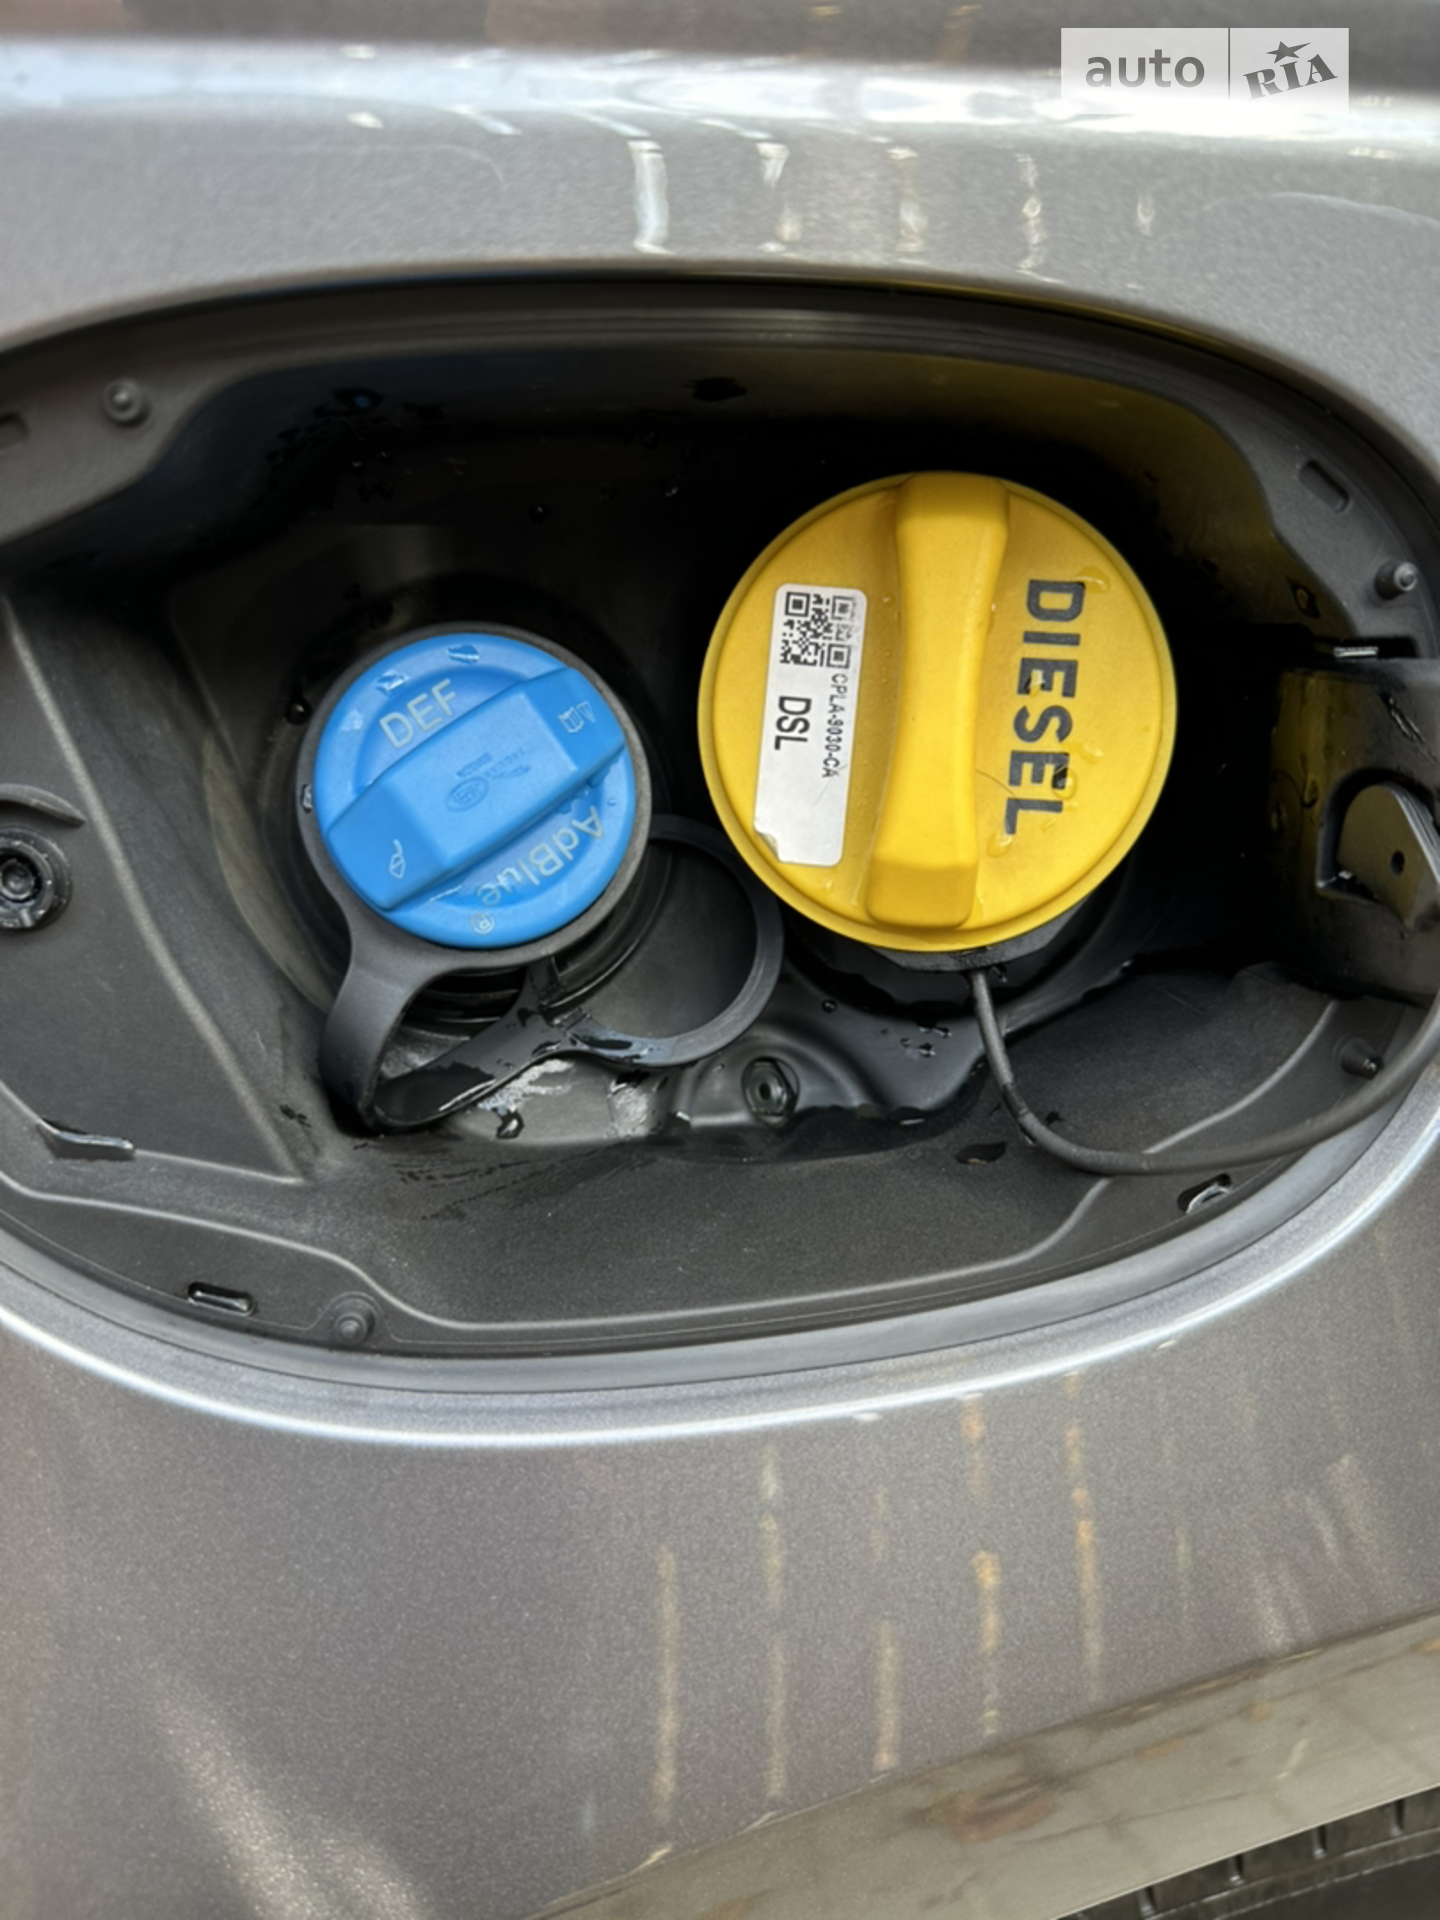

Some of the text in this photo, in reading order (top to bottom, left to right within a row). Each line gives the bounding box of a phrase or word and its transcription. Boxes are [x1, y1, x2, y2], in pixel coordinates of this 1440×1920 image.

[379, 678, 456, 749] DEF
[774, 695, 812, 751] DSL
[822, 672, 848, 778] CPLA-9030-CA
[1005, 579, 1086, 835] DIESEL
